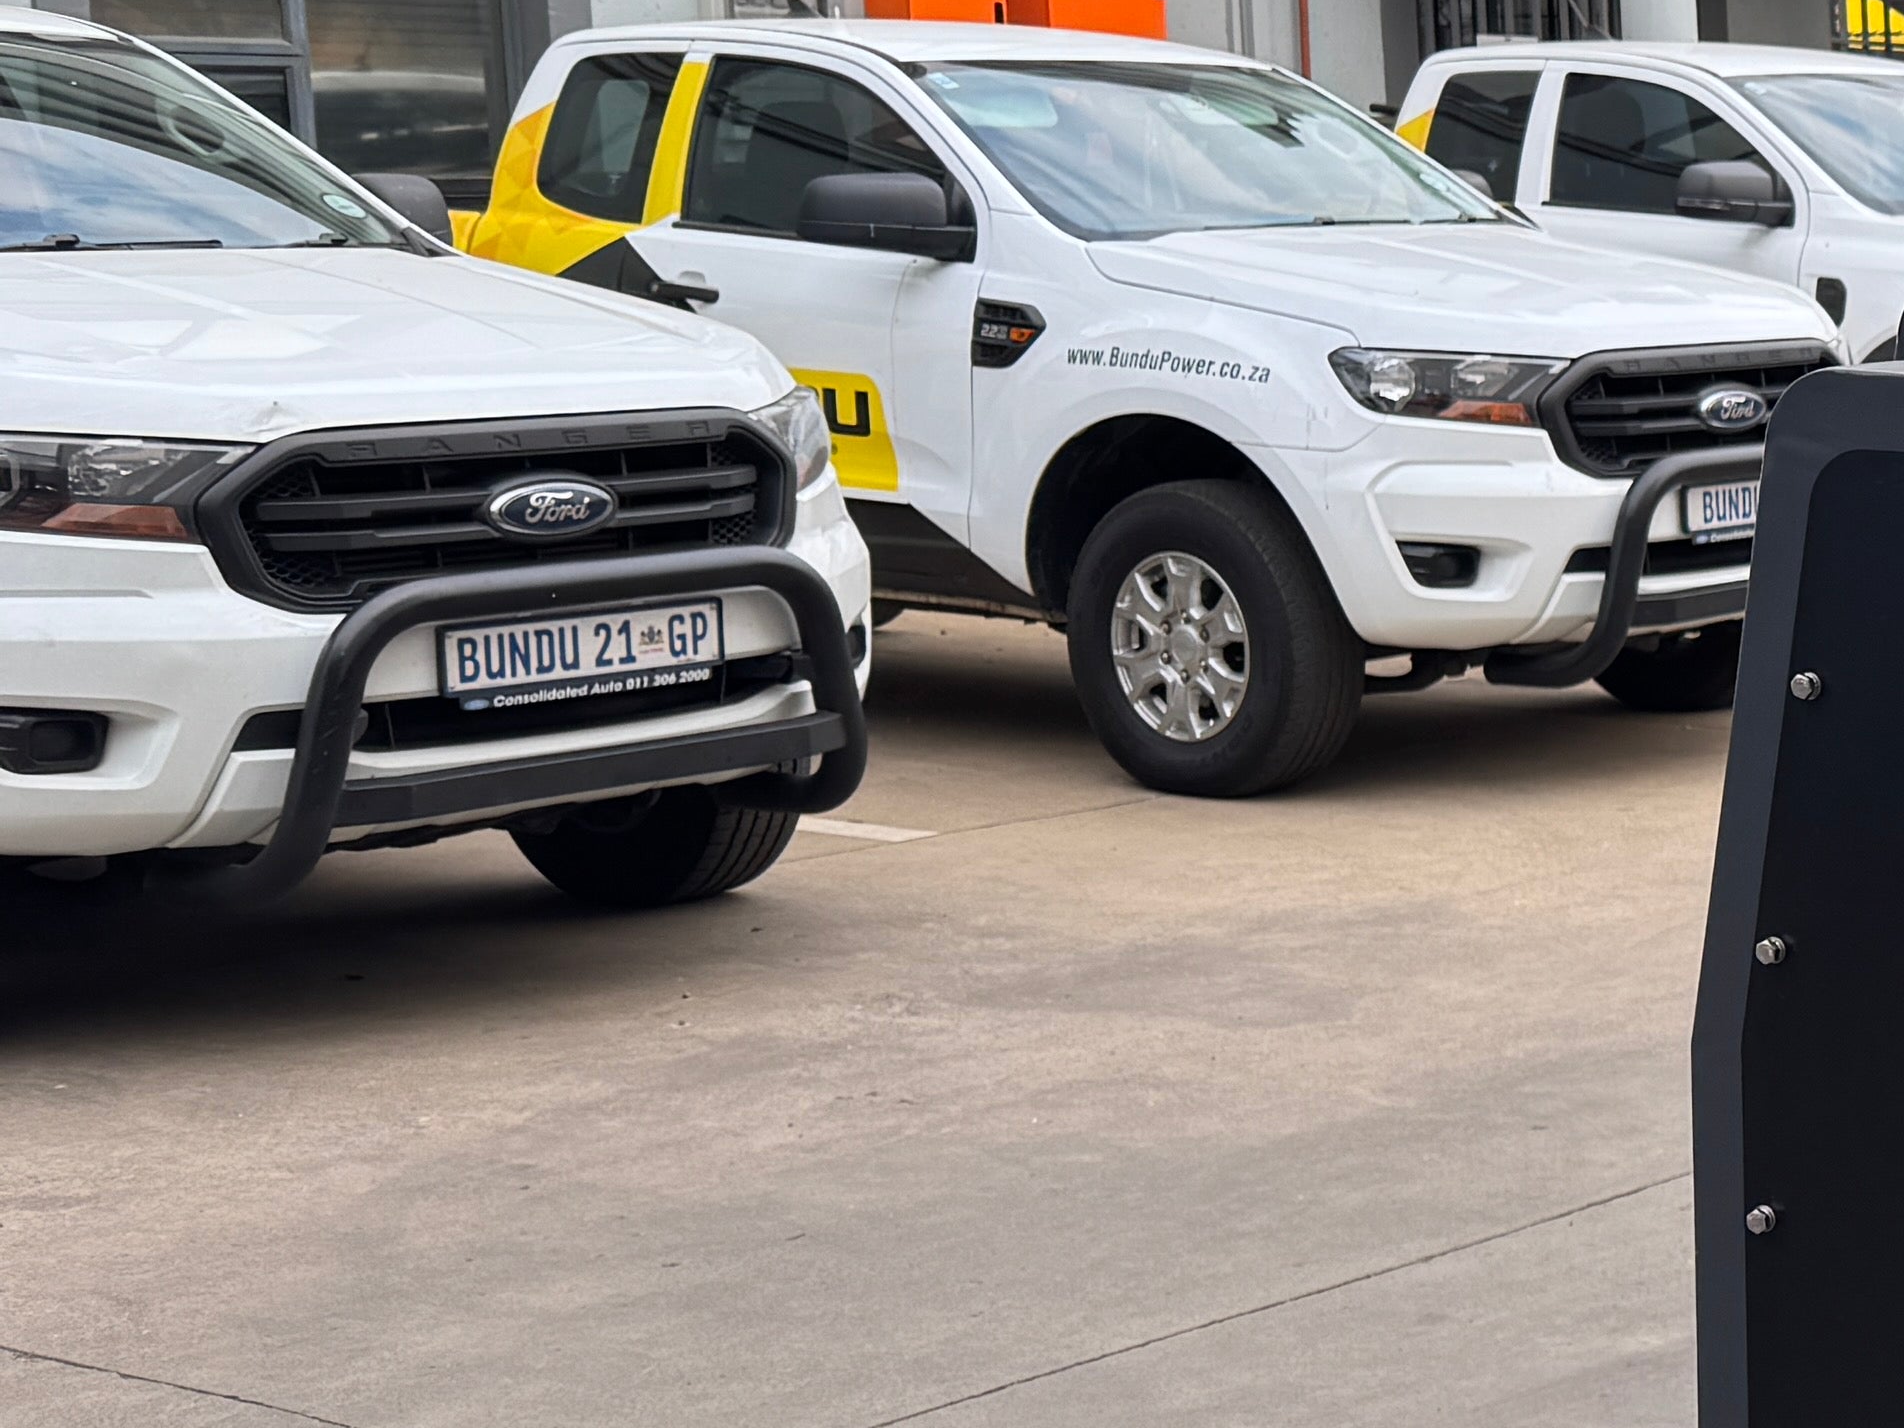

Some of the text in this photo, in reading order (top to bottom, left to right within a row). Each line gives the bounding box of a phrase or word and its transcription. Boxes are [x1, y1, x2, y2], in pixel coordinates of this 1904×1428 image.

[1067, 346, 1271, 384] www.BunduPower.co.za
[525, 490, 592, 525] Ford
[1702, 484, 1758, 525] BUND
[456, 611, 708, 684] BUNDU 21 GP
[493, 683, 588, 708] Consolidated
[590, 681, 622, 696] Auto
[625, 676, 649, 691] 011
